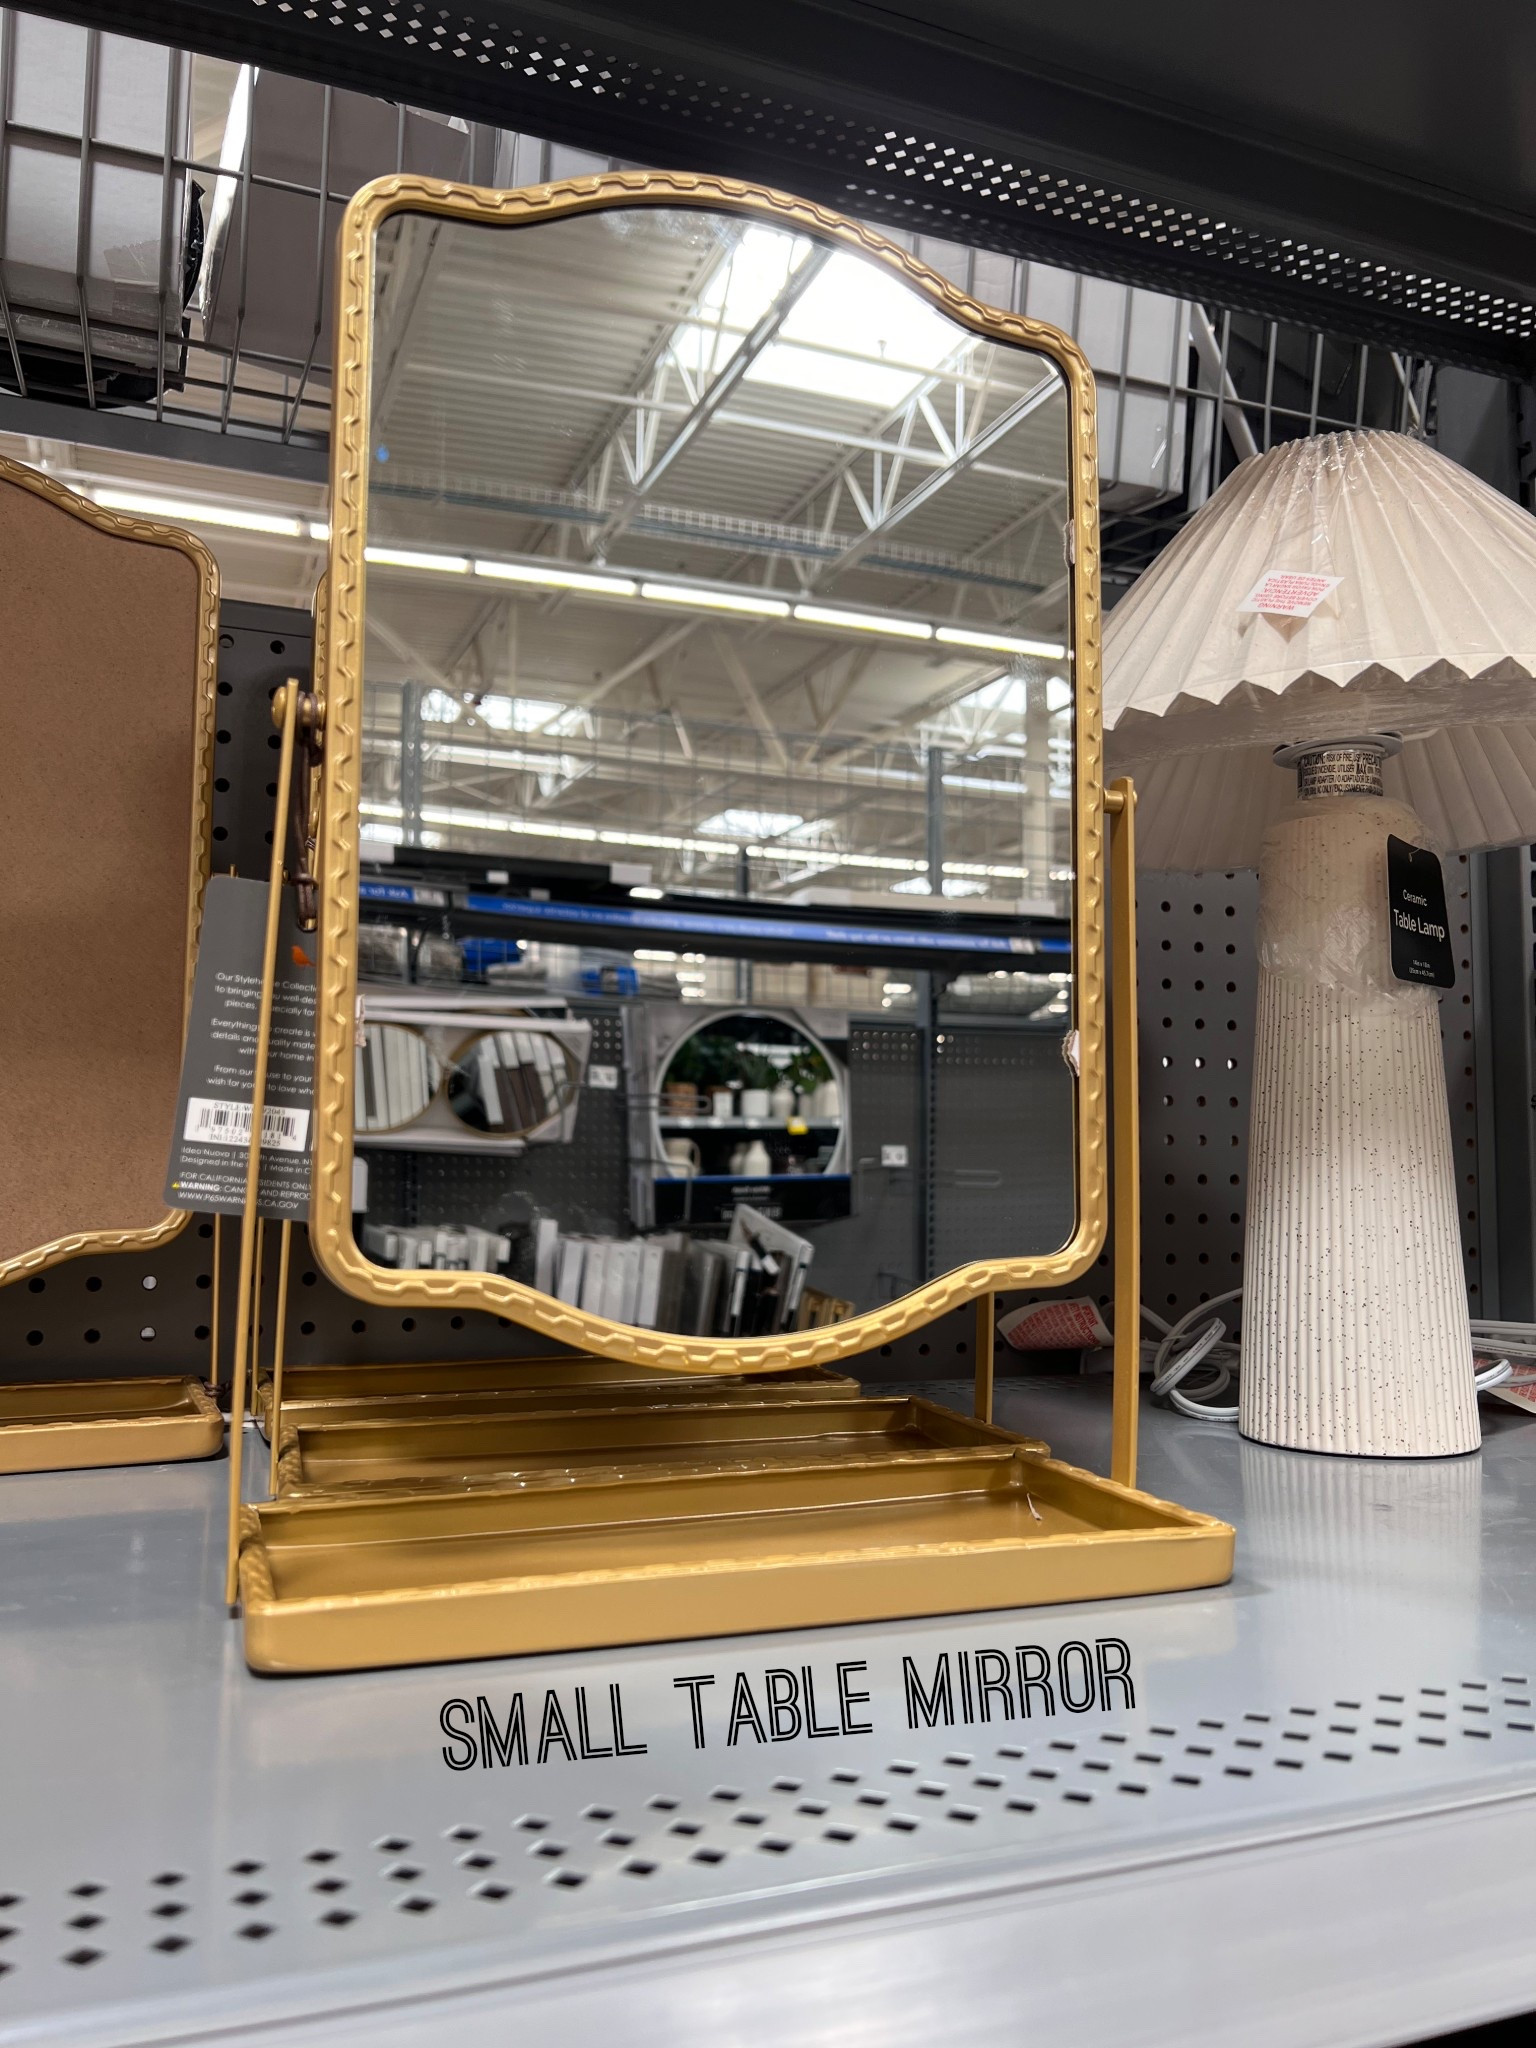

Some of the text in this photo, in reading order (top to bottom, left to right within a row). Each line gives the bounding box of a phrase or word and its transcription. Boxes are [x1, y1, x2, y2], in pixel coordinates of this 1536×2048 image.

[1402, 889, 1428, 906] Ceramic
[1394, 908, 1445, 942] Table Lamp
[216, 972, 234, 981] Our
[215, 985, 226, 993] to
[211, 1018, 258, 1032] Everything
[274, 1028, 304, 1036] create
[210, 1031, 241, 1040] details
[268, 1039, 292, 1048] uality
[280, 1051, 305, 1060] home
[214, 1064, 237, 1074] From
[294, 1074, 312, 1083] your
[206, 1076, 226, 1086] wish
[228, 1078, 240, 1087] for
[278, 1085, 296, 1093] love
[182, 1146, 202, 1154] Idea
[204, 1148, 231, 1158] Nuova
[182, 1156, 220, 1166] Designed
[230, 1160, 244, 1168] the
[270, 1165, 294, 1173] Made
[180, 1172, 198, 1180] FOR
[200, 1173, 248, 1184] CALIFORNIA
[260, 1180, 290, 1190] SIDENTS
[180, 1180, 222, 1192] WARNING:
[261, 1189, 279, 1197] AND
[280, 1190, 311, 1200] REPROD
